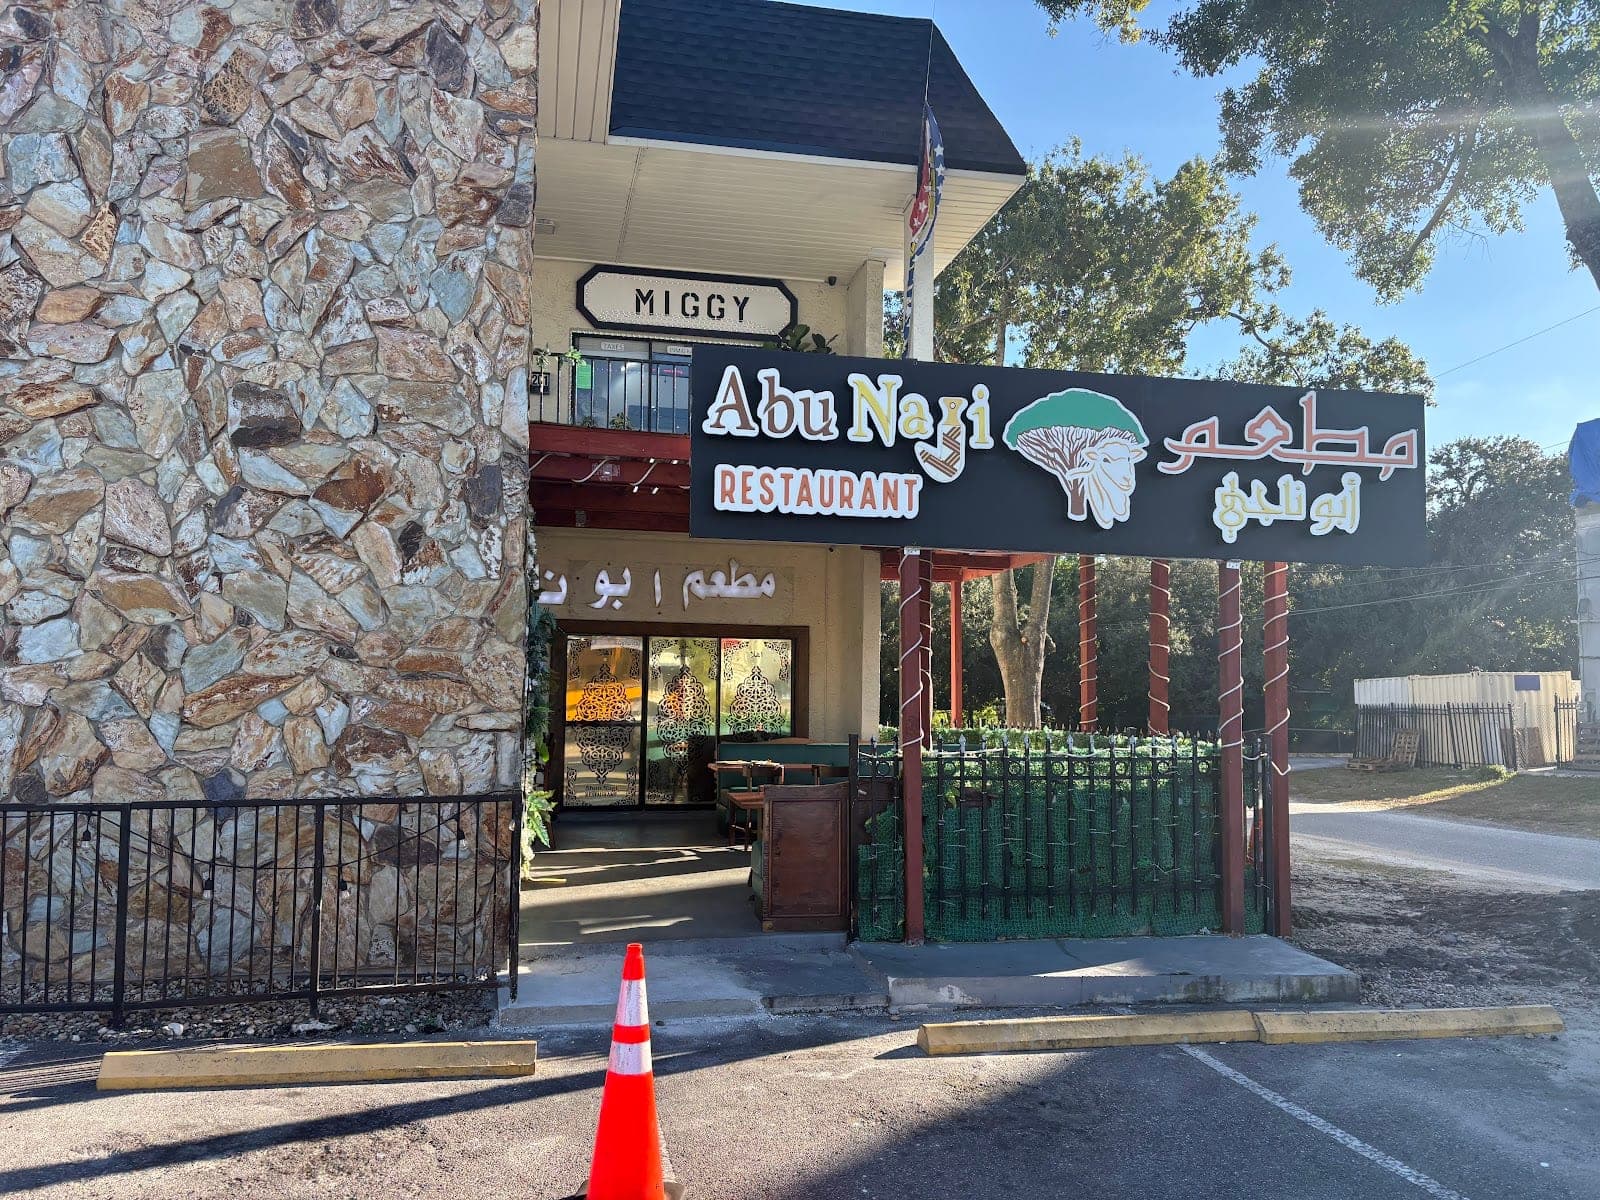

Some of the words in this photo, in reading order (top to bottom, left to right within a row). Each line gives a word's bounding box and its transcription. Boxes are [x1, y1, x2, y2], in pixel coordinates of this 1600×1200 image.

[634, 288, 750, 323] MIGGY
[704, 367, 837, 440] Abu
[1157, 391, 1417, 480] مطعم
[716, 466, 921, 516] RESTAURANT
[683, 557, 775, 611] مطعم
